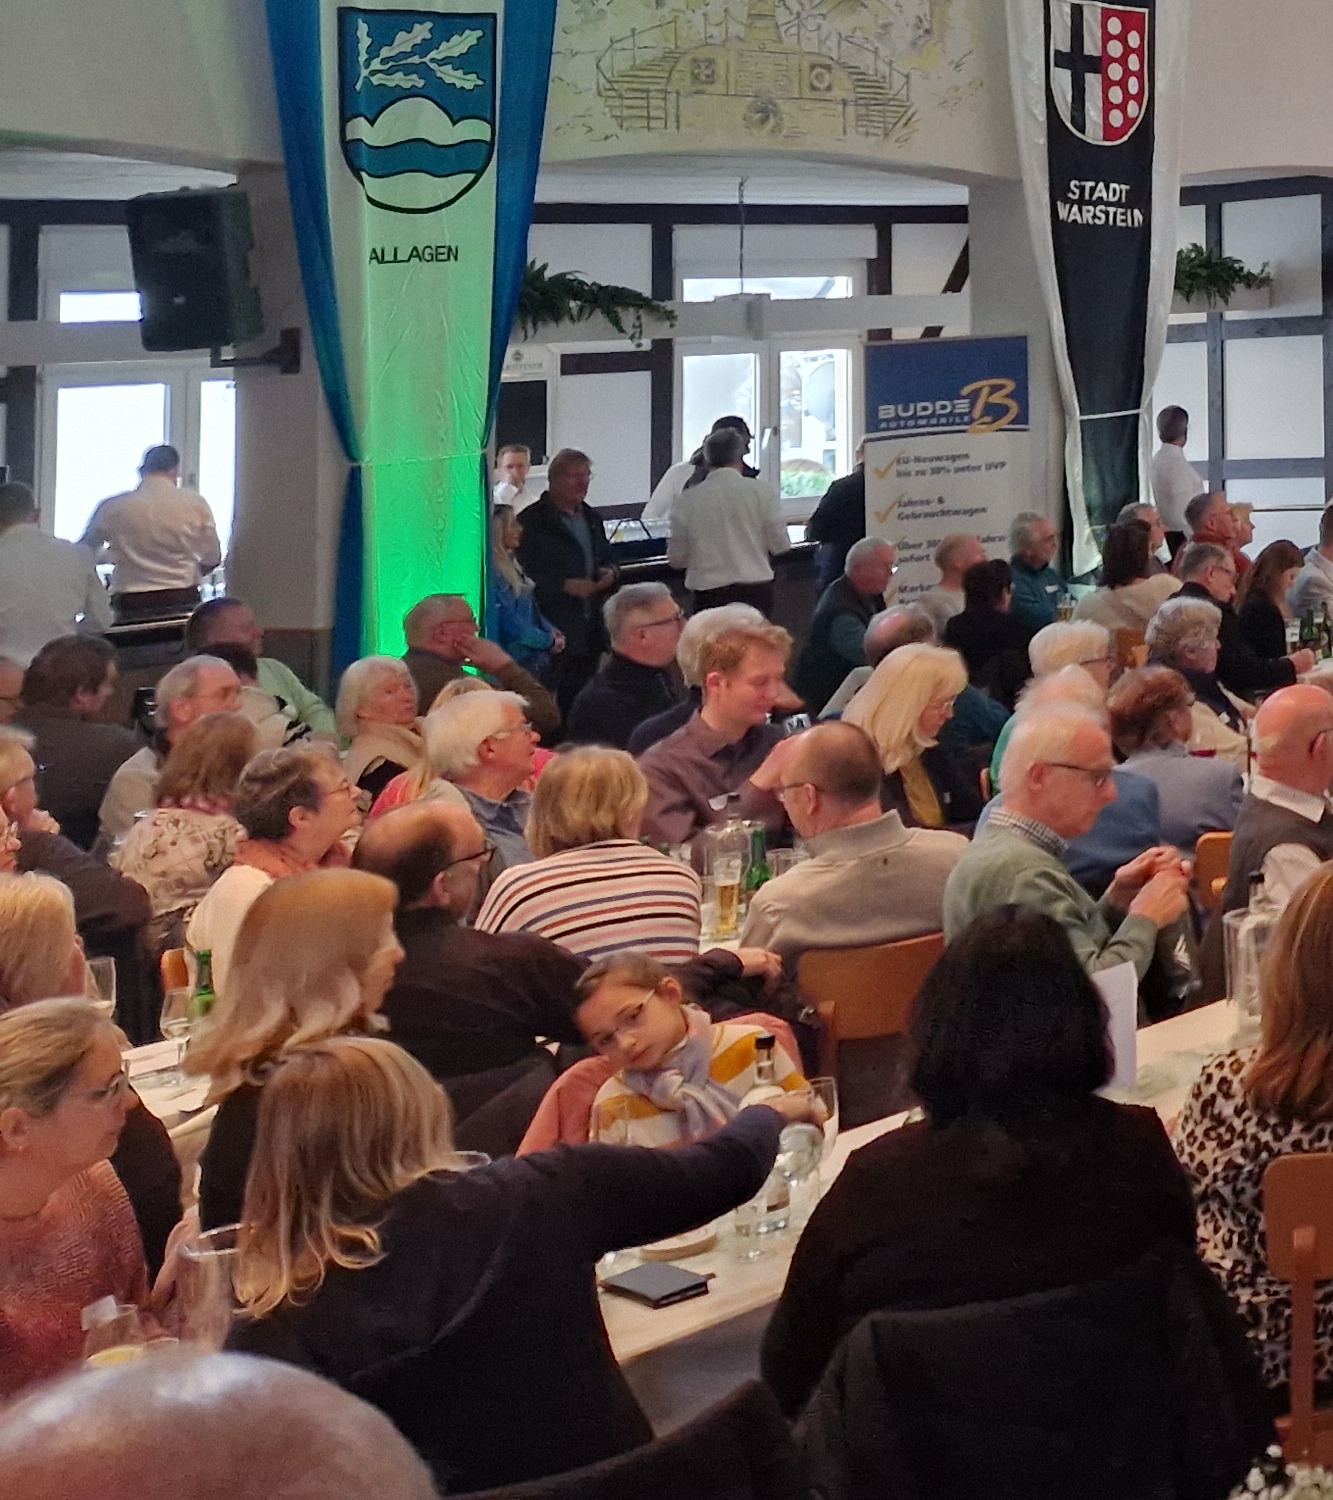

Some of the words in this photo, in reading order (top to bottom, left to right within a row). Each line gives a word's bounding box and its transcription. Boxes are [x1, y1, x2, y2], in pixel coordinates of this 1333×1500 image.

[1067, 179, 1130, 203] STADT
[1056, 200, 1144, 228] WARSTEIN
[369, 245, 459, 265] ALLAGEN
[878, 398, 971, 420] BUDDE
[879, 415, 970, 430] AUTOMOBILE
